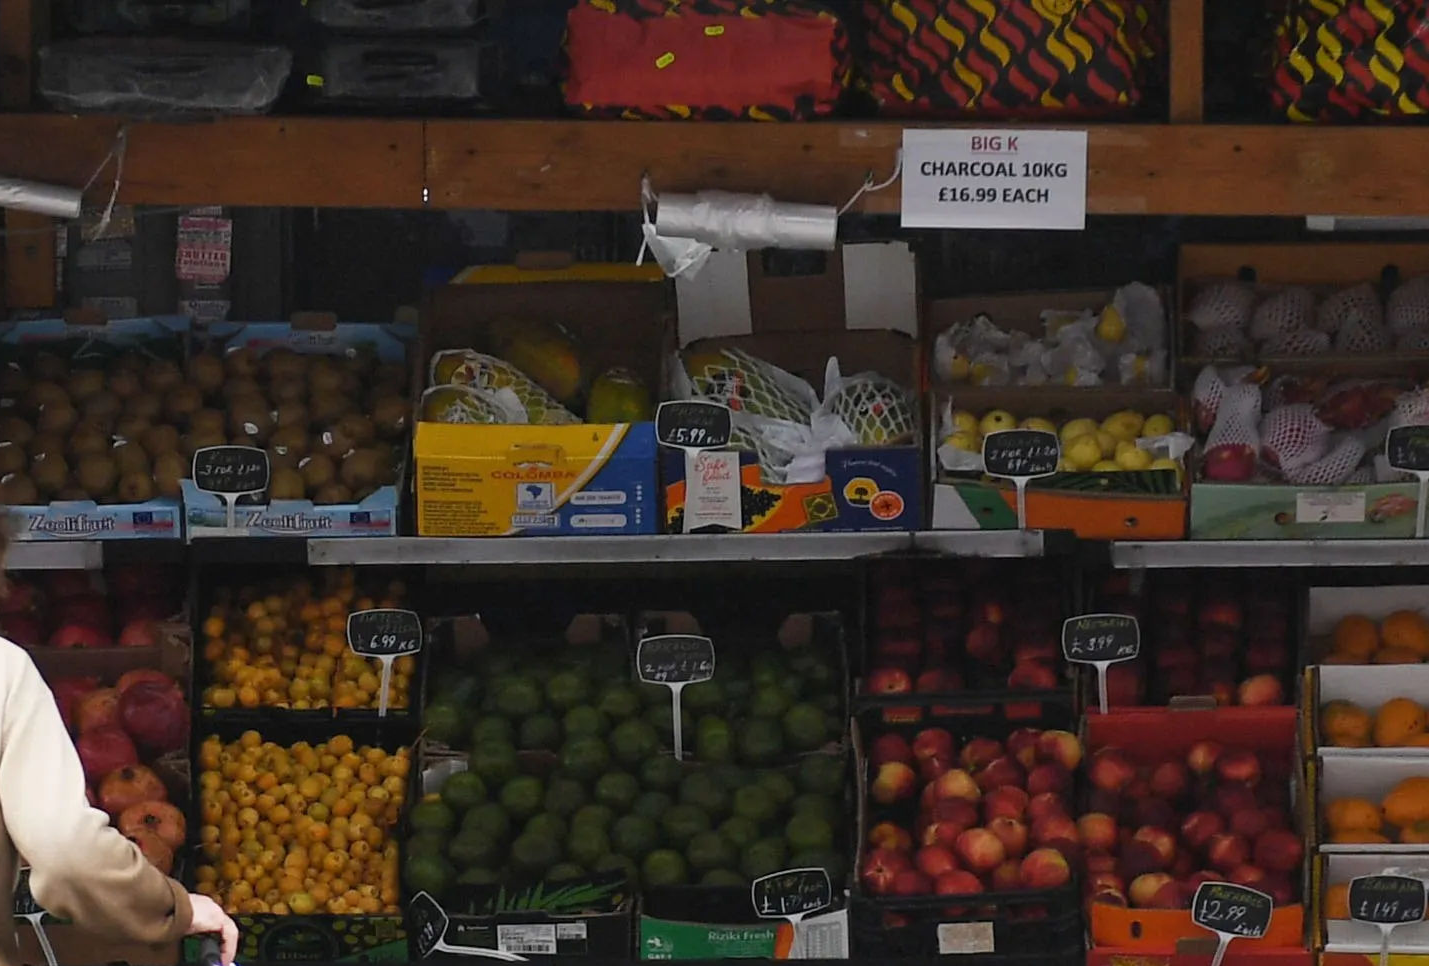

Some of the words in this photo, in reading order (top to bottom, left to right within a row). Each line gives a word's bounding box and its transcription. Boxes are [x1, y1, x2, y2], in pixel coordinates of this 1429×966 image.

[971, 136, 1001, 151] BIG
[1008, 136, 1019, 151] K
[921, 161, 1016, 177] CHARCOAL
[1022, 162, 1067, 178] 10KG
[938, 186, 997, 203] £16.99
[1002, 188, 1049, 203] EACH
[1199, 899, 1248, 922] £2.99
[743, 929, 776, 941] Fresh
